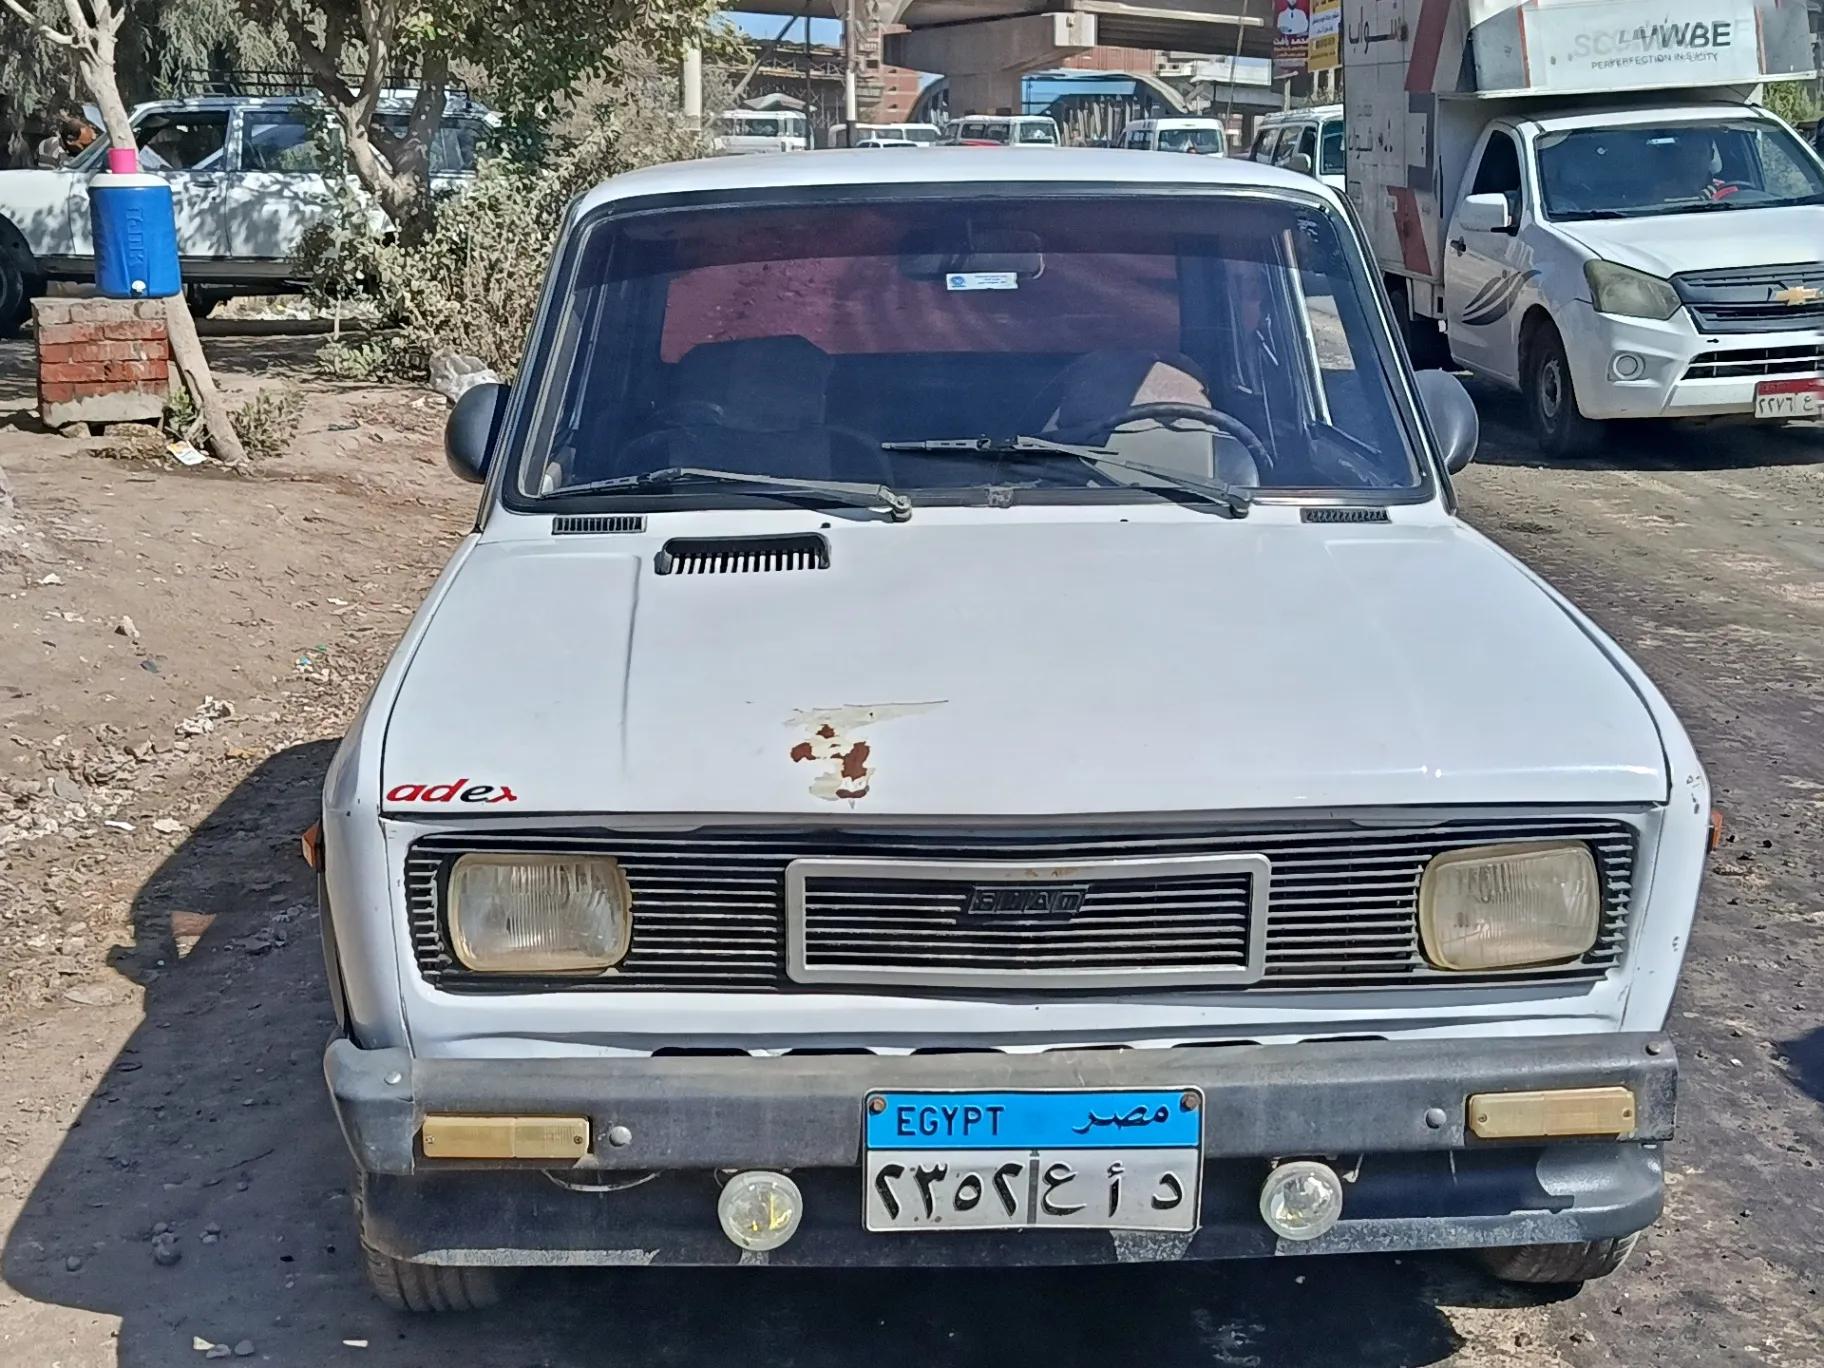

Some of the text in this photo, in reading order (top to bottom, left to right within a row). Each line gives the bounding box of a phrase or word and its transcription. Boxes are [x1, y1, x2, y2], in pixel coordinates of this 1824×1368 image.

[386, 778, 518, 803] adex
[896, 1105, 1005, 1137] EGYPT
[1072, 1103, 1171, 1135] مصر
[875, 1162, 1026, 1220] ٢٣٥٢
